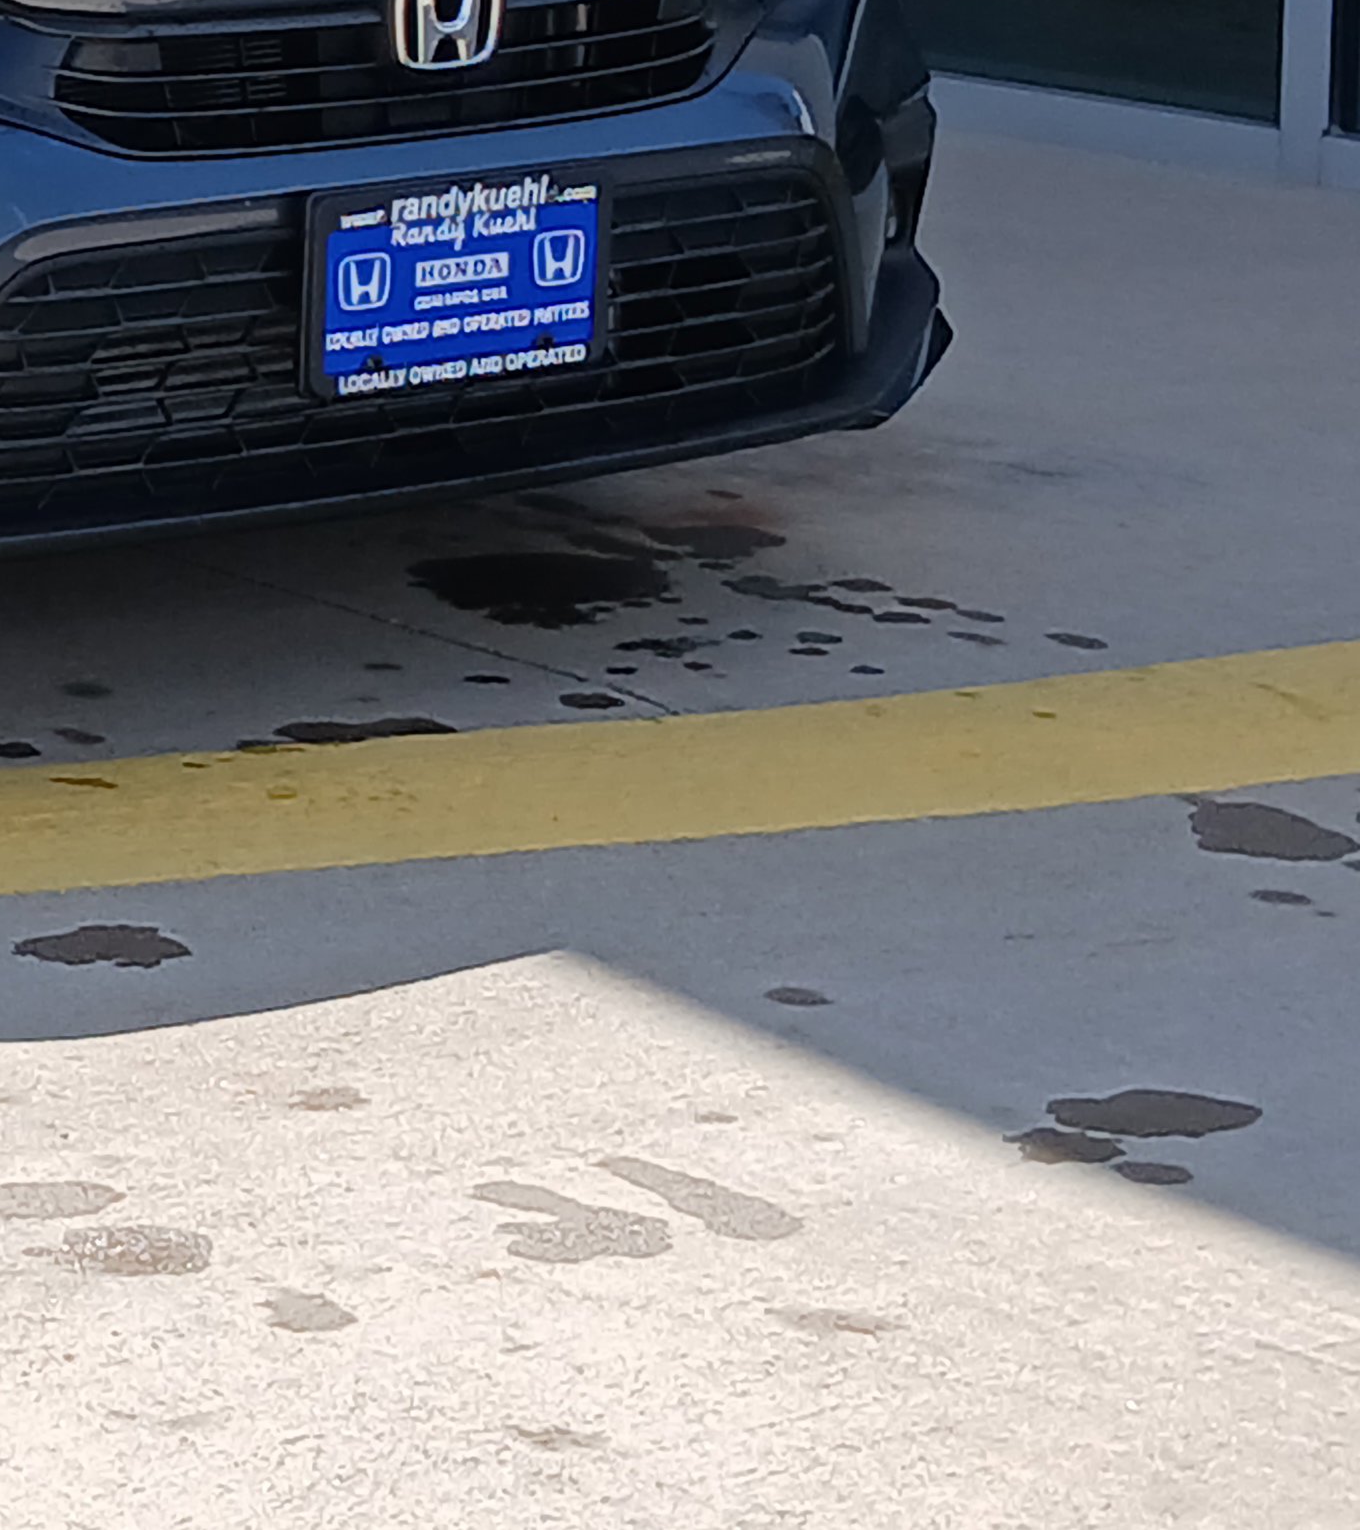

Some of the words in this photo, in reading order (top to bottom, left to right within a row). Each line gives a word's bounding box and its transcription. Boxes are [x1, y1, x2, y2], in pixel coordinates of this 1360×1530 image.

[391, 174, 549, 223] randykuehl
[391, 218, 465, 251] Randy
[472, 207, 537, 238] Kuehl
[421, 257, 503, 282] HONDA
[338, 367, 408, 396] LOCALLY
[409, 359, 468, 385] OWNED
[469, 355, 503, 377] AND
[504, 343, 587, 372] OPERATED
